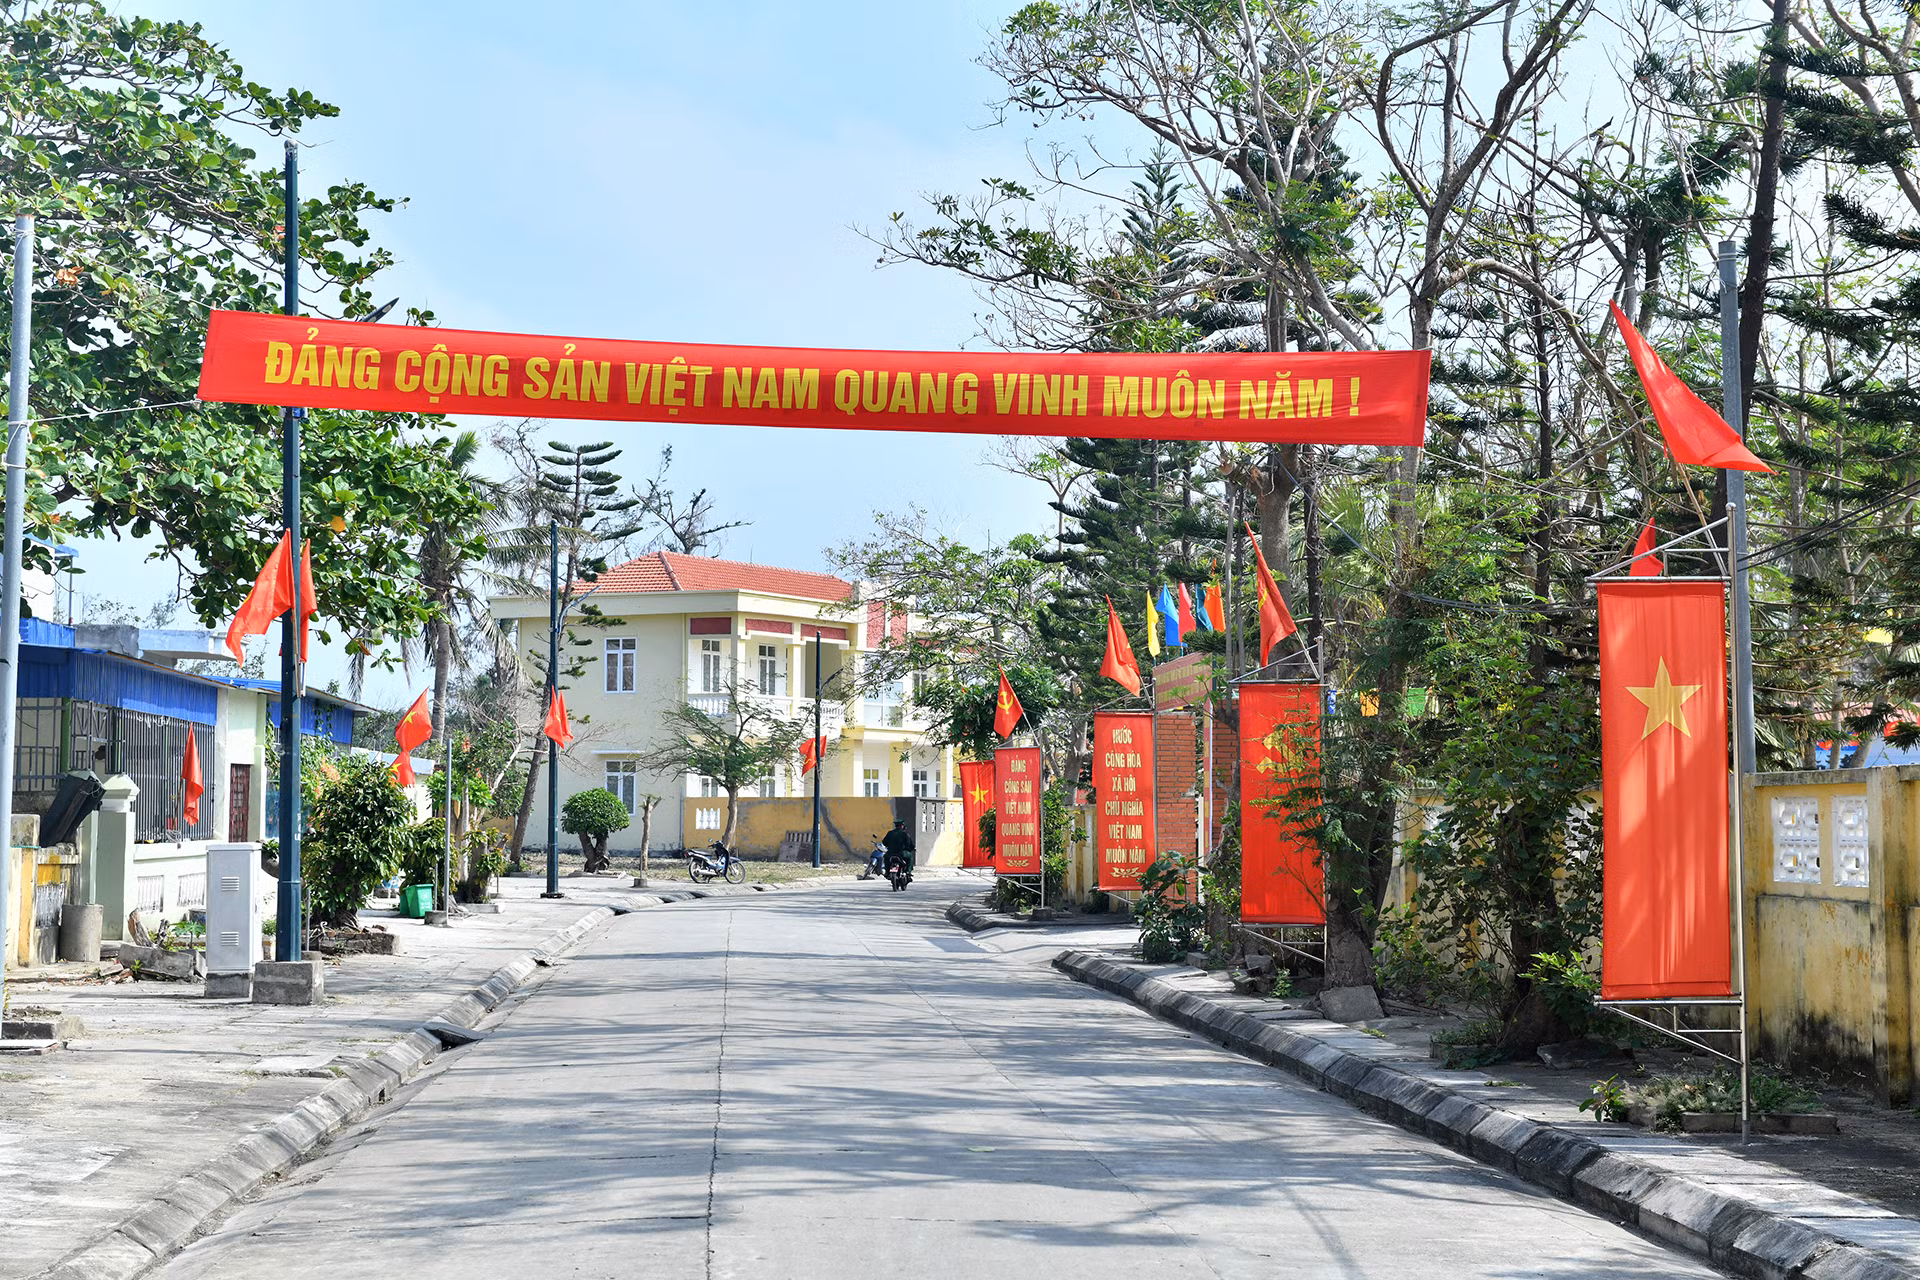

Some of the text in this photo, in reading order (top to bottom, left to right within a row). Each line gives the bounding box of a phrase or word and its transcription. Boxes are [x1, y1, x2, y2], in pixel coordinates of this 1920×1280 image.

[264, 327, 382, 391] ĐẢNG
[395, 343, 509, 404] CỘNG
[523, 343, 611, 403] SẢN
[626, 356, 713, 415] VIỆT
[722, 366, 821, 410] NAM
[834, 368, 979, 416] QUANG
[993, 373, 1089, 417] VINH
[1103, 370, 1226, 419] MUÔN
[1239, 371, 1333, 419] NĂM
[1112, 725, 1133, 744] NƯỚC
[1105, 749, 1142, 771] CỘNG HÒA
[1111, 774, 1137, 795] XÃ HỘI
[1105, 795, 1120, 816] CHỦ
[1121, 799, 1144, 817] NGHĨA
[1108, 821, 1143, 842] VIỆT NAM
[1105, 846, 1146, 864] MUÔN NĂM
